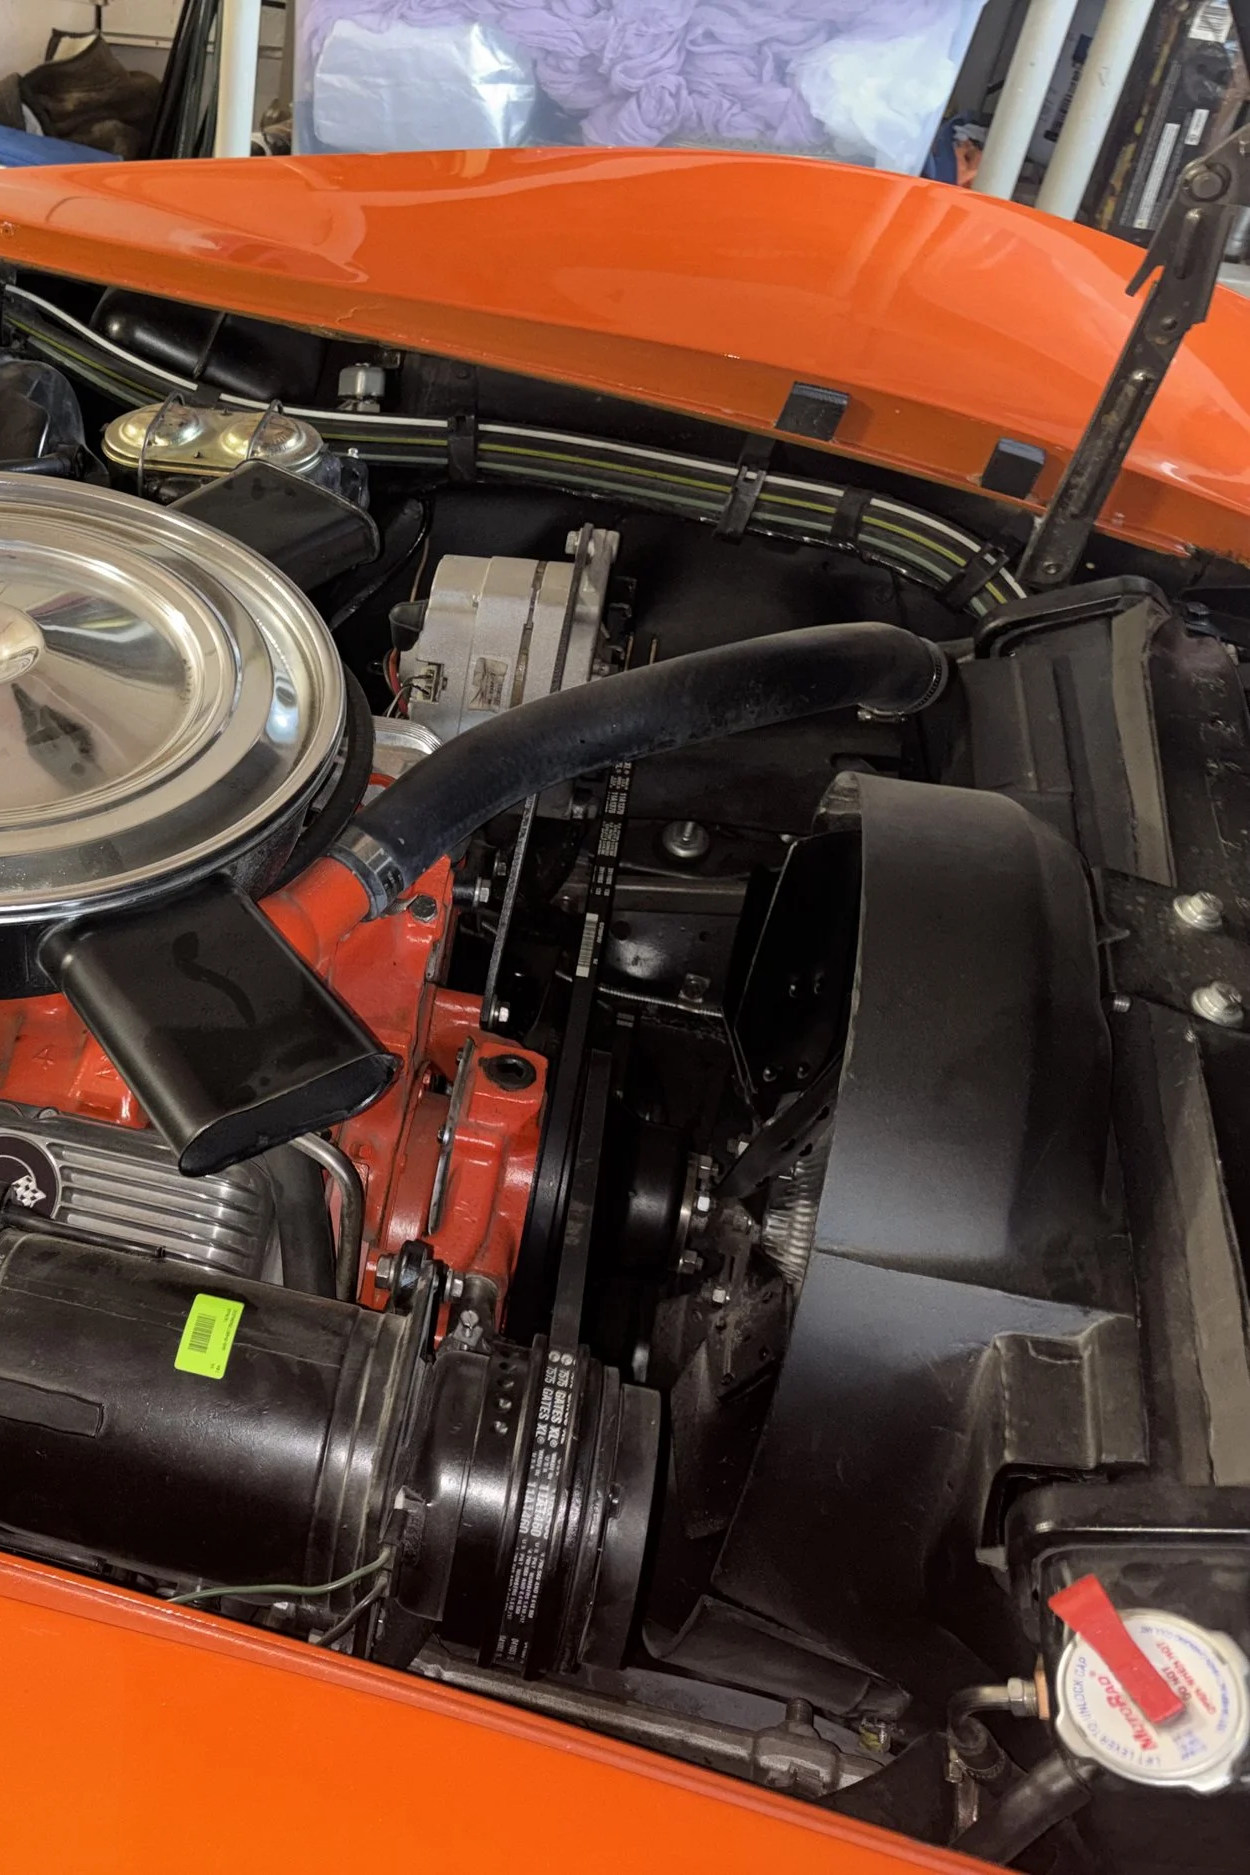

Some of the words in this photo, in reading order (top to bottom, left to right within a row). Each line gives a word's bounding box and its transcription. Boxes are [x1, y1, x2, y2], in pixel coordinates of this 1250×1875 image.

[544, 1366, 557, 1385] 7575
[556, 1368, 570, 1388] 7575
[538, 1387, 554, 1421] GATES
[550, 1389, 567, 1424] GATES
[1155, 1641, 1175, 1660] HOT
[1074, 1656, 1087, 1678] CAP
[1161, 1666, 1180, 1685] NOT
[1173, 1660, 1195, 1686] WHEN
[1072, 1679, 1092, 1720] UNLOCK
[1086, 1722, 1101, 1738] TO
